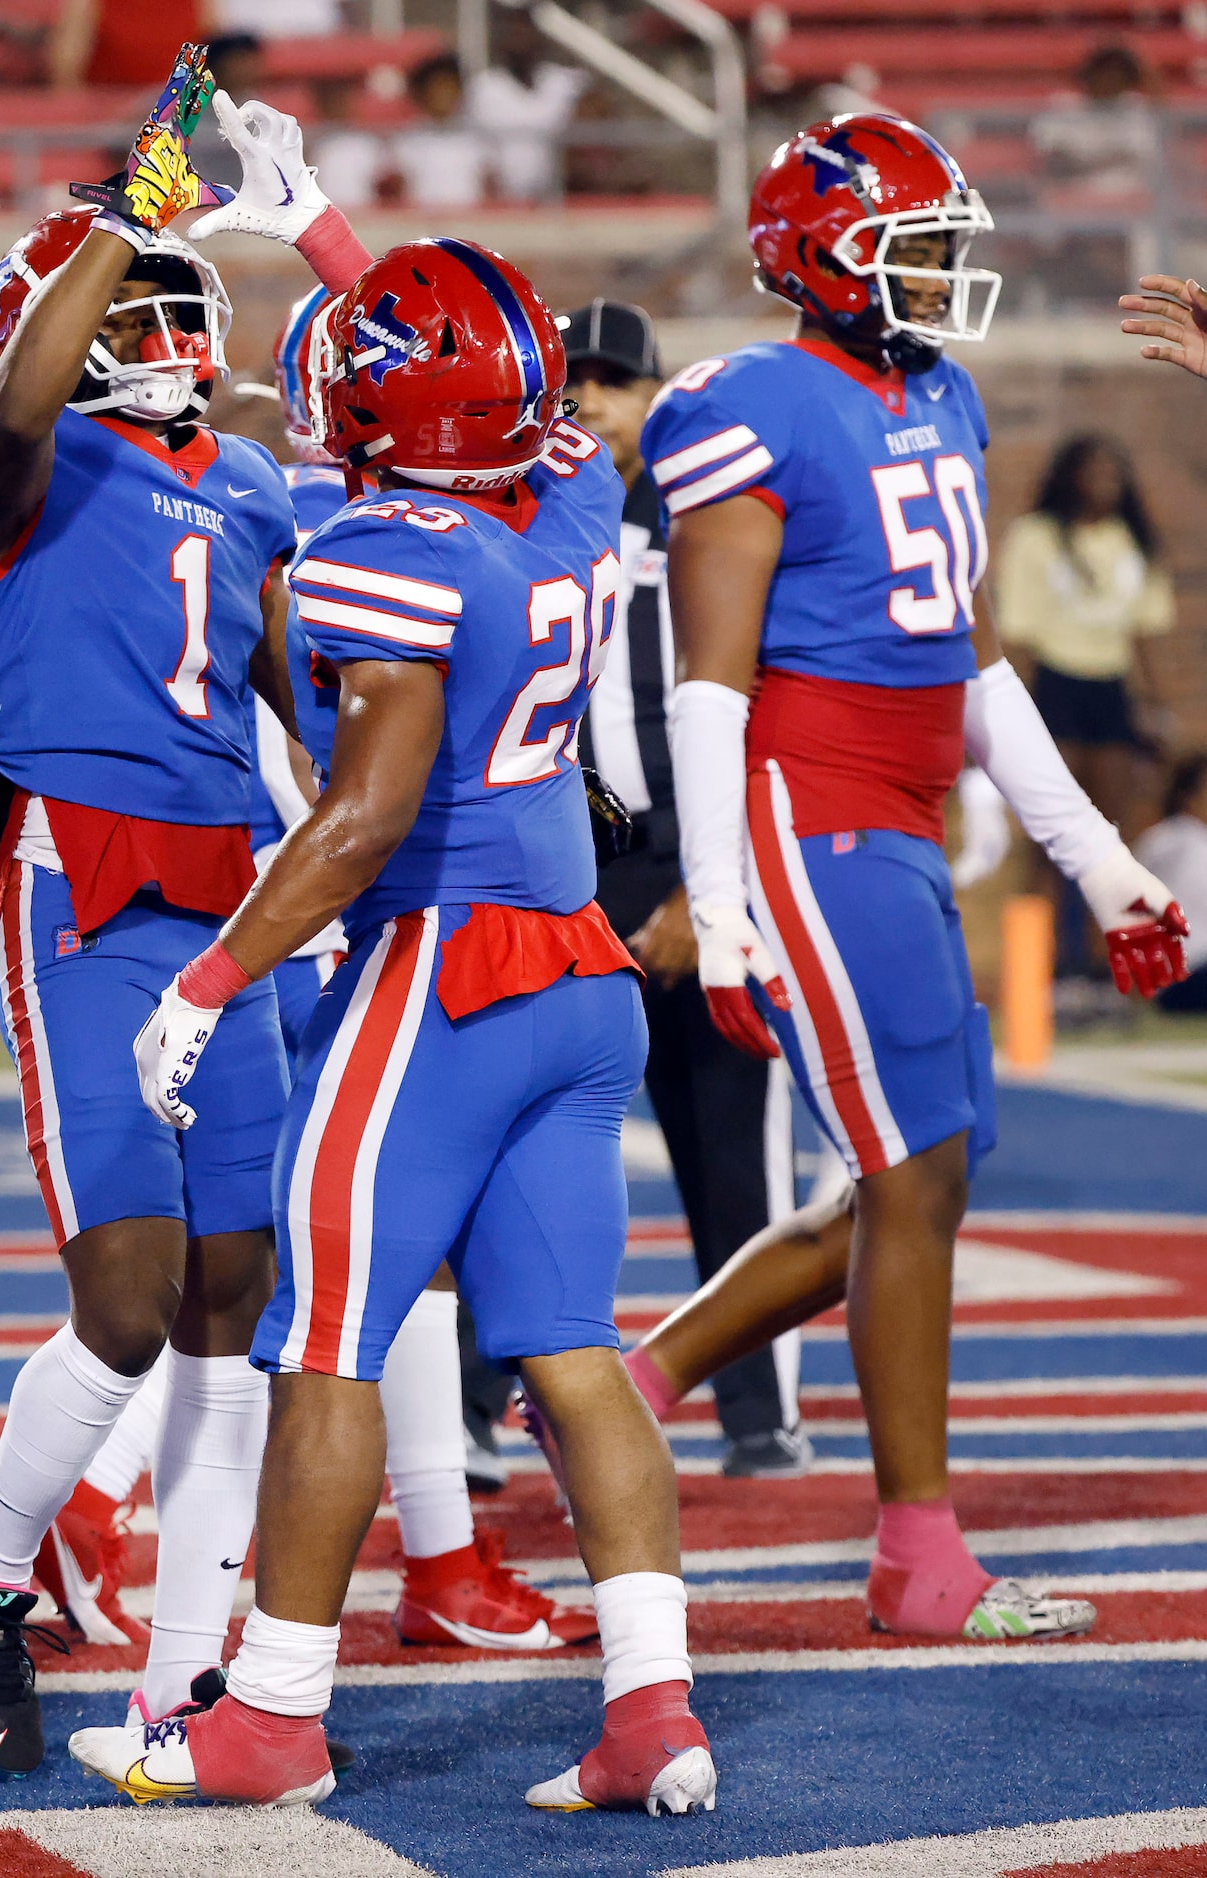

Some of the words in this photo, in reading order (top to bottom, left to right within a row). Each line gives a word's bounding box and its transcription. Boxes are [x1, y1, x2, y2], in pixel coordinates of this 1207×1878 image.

[151, 491, 225, 537] PANTHERS
[870, 453, 989, 636] 50
[163, 532, 212, 720] 1
